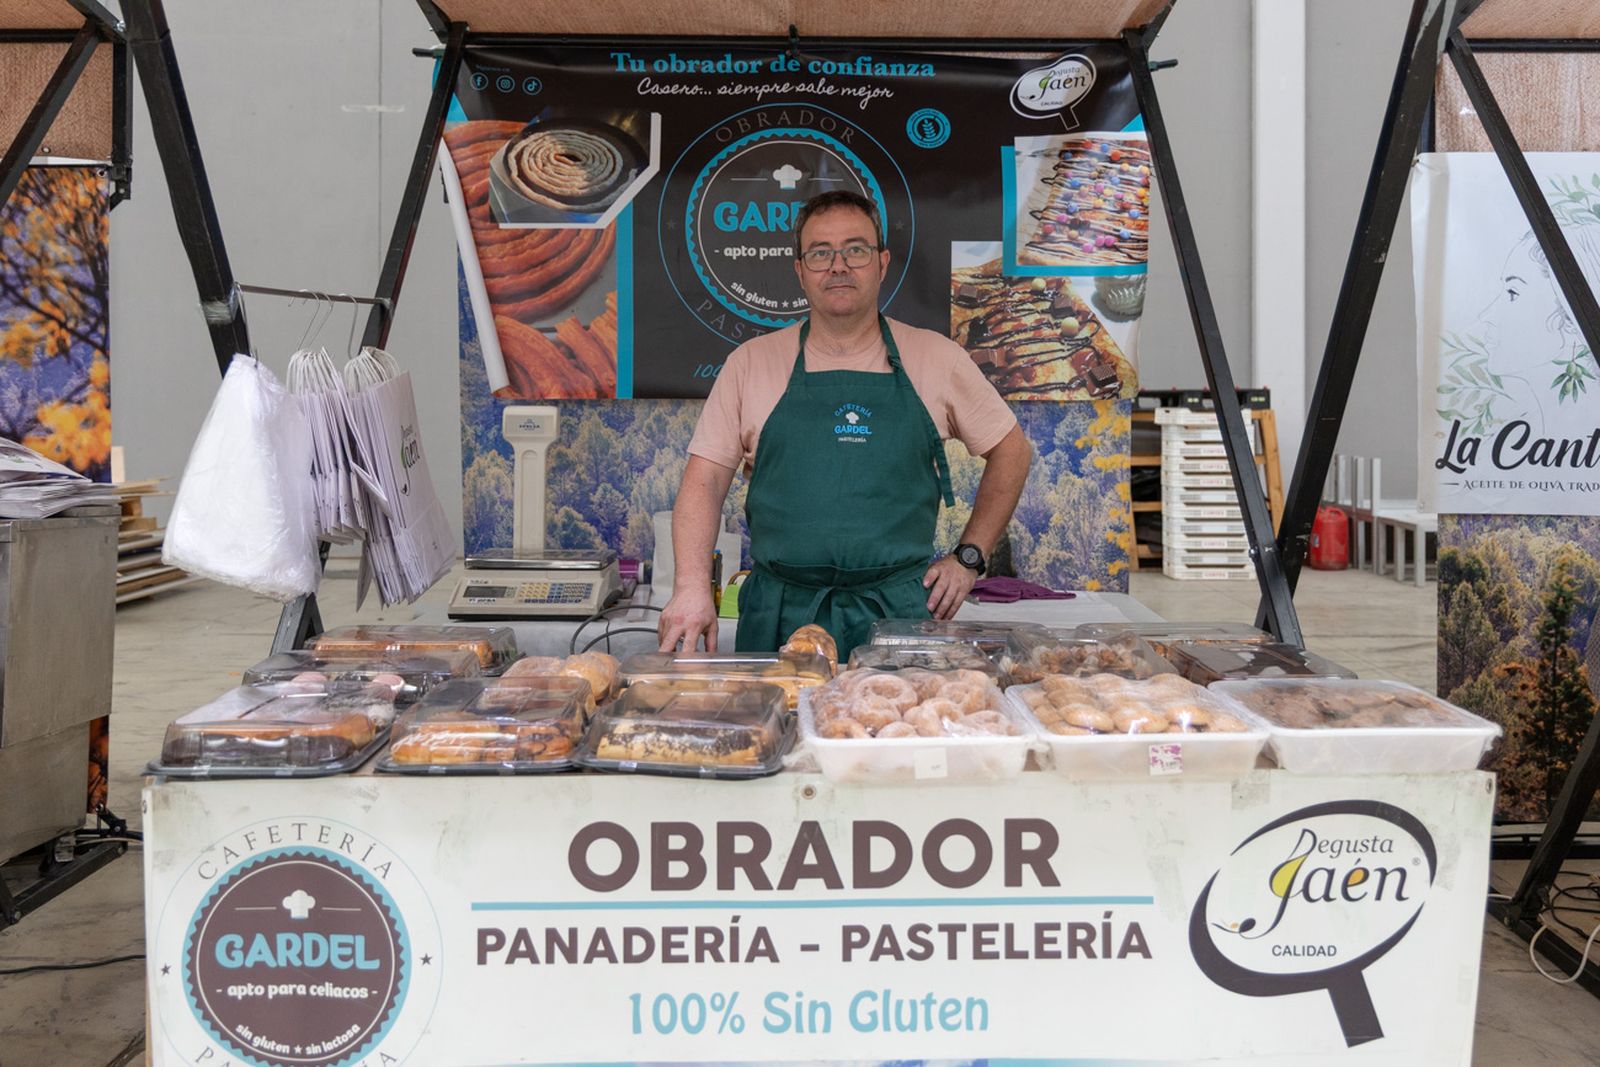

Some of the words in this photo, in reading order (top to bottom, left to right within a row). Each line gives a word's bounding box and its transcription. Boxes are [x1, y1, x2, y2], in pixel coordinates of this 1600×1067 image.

[610, 52, 646, 73] Tu
[653, 53, 763, 74] obrador
[770, 54, 800, 73] de
[808, 56, 936, 77] confianza
[717, 81, 792, 101] siempre
[795, 77, 838, 95] sabe
[840, 84, 894, 110] mejor
[715, 110, 854, 143] OBRADOR
[723, 246, 757, 260] apto
[759, 247, 793, 260] para
[731, 281, 746, 295] sin
[745, 292, 778, 308] gluten
[792, 298, 808, 308] sin
[834, 424, 873, 436] GARDEL
[1435, 419, 1482, 474] La
[1463, 480, 1506, 490] ACEITE
[1510, 480, 1525, 489] DE
[1528, 480, 1566, 492] OLIVA
[198, 822, 392, 880] CAFETERÍA
[568, 818, 1062, 893] OBRADOR
[1288, 827, 1394, 859] Degusta
[1242, 856, 1410, 940] Jaén
[215, 932, 381, 970] GARDEL
[476, 915, 780, 966] PANADERÍA
[842, 910, 1153, 962] PASTELERÍA
[1271, 944, 1337, 957] CALIDAD
[227, 982, 265, 1000] apto
[267, 983, 307, 999] para
[309, 981, 369, 999] celiacos
[629, 990, 746, 1036] 100%
[762, 990, 832, 1035] Sin
[848, 988, 989, 1033] Gluten
[236, 1022, 252, 1041] sin
[252, 1035, 290, 1054] gluten
[306, 1039, 322, 1056] sin
[321, 1022, 361, 1052] lactosa
